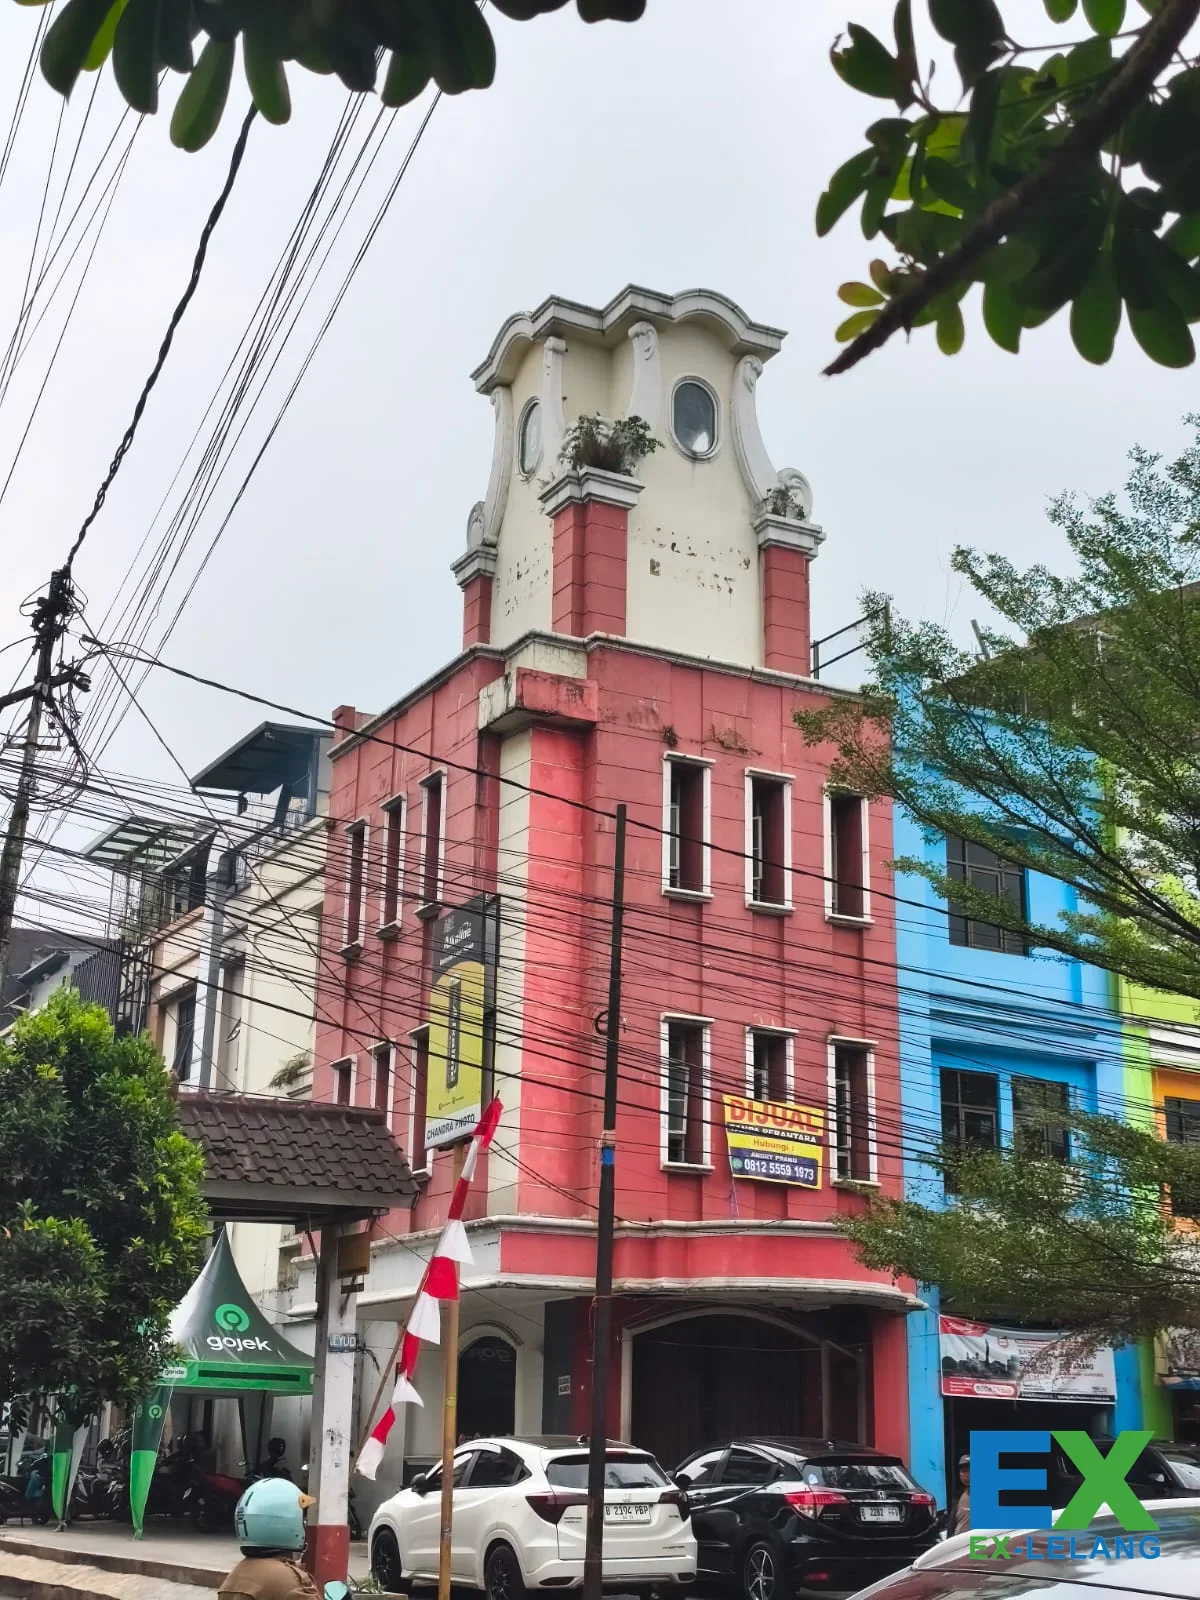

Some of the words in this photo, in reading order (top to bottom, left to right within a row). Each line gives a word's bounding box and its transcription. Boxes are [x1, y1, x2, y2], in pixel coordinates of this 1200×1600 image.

[730, 1099, 818, 1133] DIJUAL
[427, 1121, 454, 1140] CHANDRA
[753, 1139, 789, 1152] Hubungi
[744, 1158, 767, 1173] 0812
[769, 1161, 792, 1176] 5559
[794, 1165, 814, 1181] 1973
[206, 1336, 272, 1351] gojek
[605, 1505, 611, 1516] B
